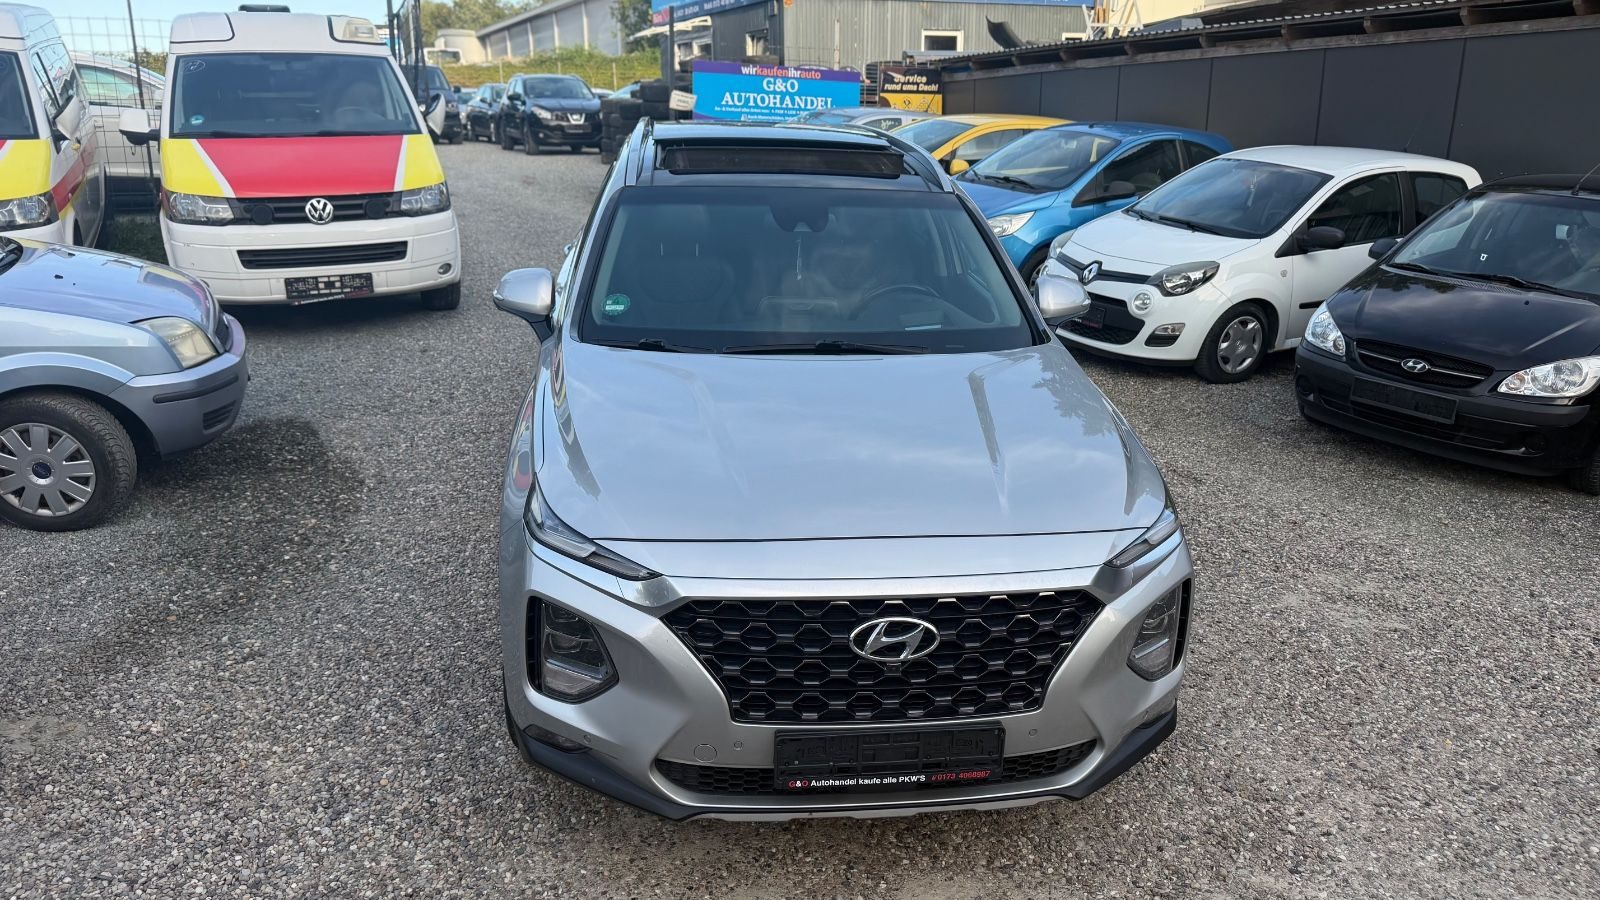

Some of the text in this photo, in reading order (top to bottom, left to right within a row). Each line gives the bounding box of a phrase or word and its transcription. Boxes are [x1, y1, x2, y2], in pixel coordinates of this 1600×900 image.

[741, 65, 822, 80] wirkaufenihrauto
[762, 77, 799, 92] G&O
[884, 83, 901, 91] rund
[918, 83, 939, 91] Dach!
[721, 91, 837, 110] AUTOHANDEL
[810, 779, 857, 787] Autohandel
[858, 777, 881, 785] kaufe
[882, 776, 897, 784] alle
